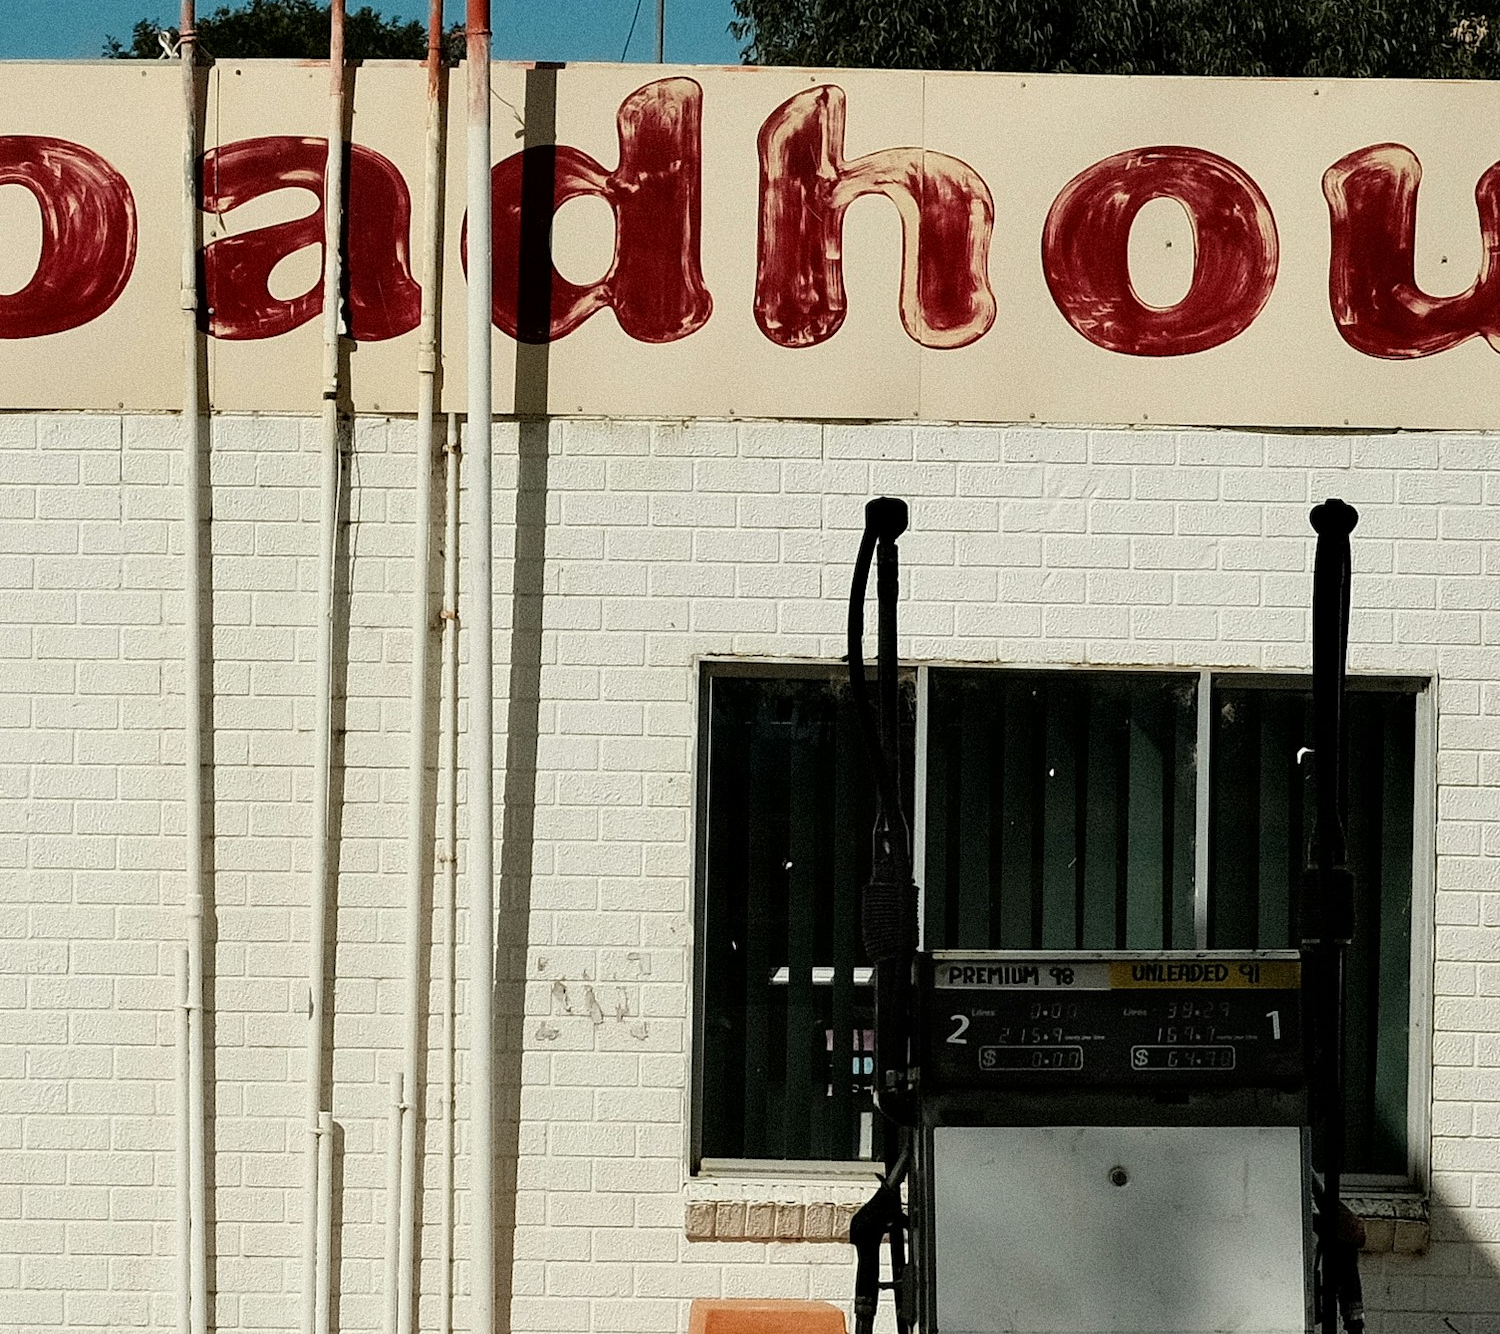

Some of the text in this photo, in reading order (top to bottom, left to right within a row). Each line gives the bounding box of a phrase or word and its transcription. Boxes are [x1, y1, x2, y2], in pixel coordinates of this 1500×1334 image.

[949, 967, 1075, 986] PREMIUM 98
[1132, 964, 1261, 984] UNLEADED 91
[945, 1014, 970, 1045] 2
[1265, 1010, 1282, 1041] 1
[982, 1049, 997, 1066] $
[1134, 1049, 1149, 1066] $
